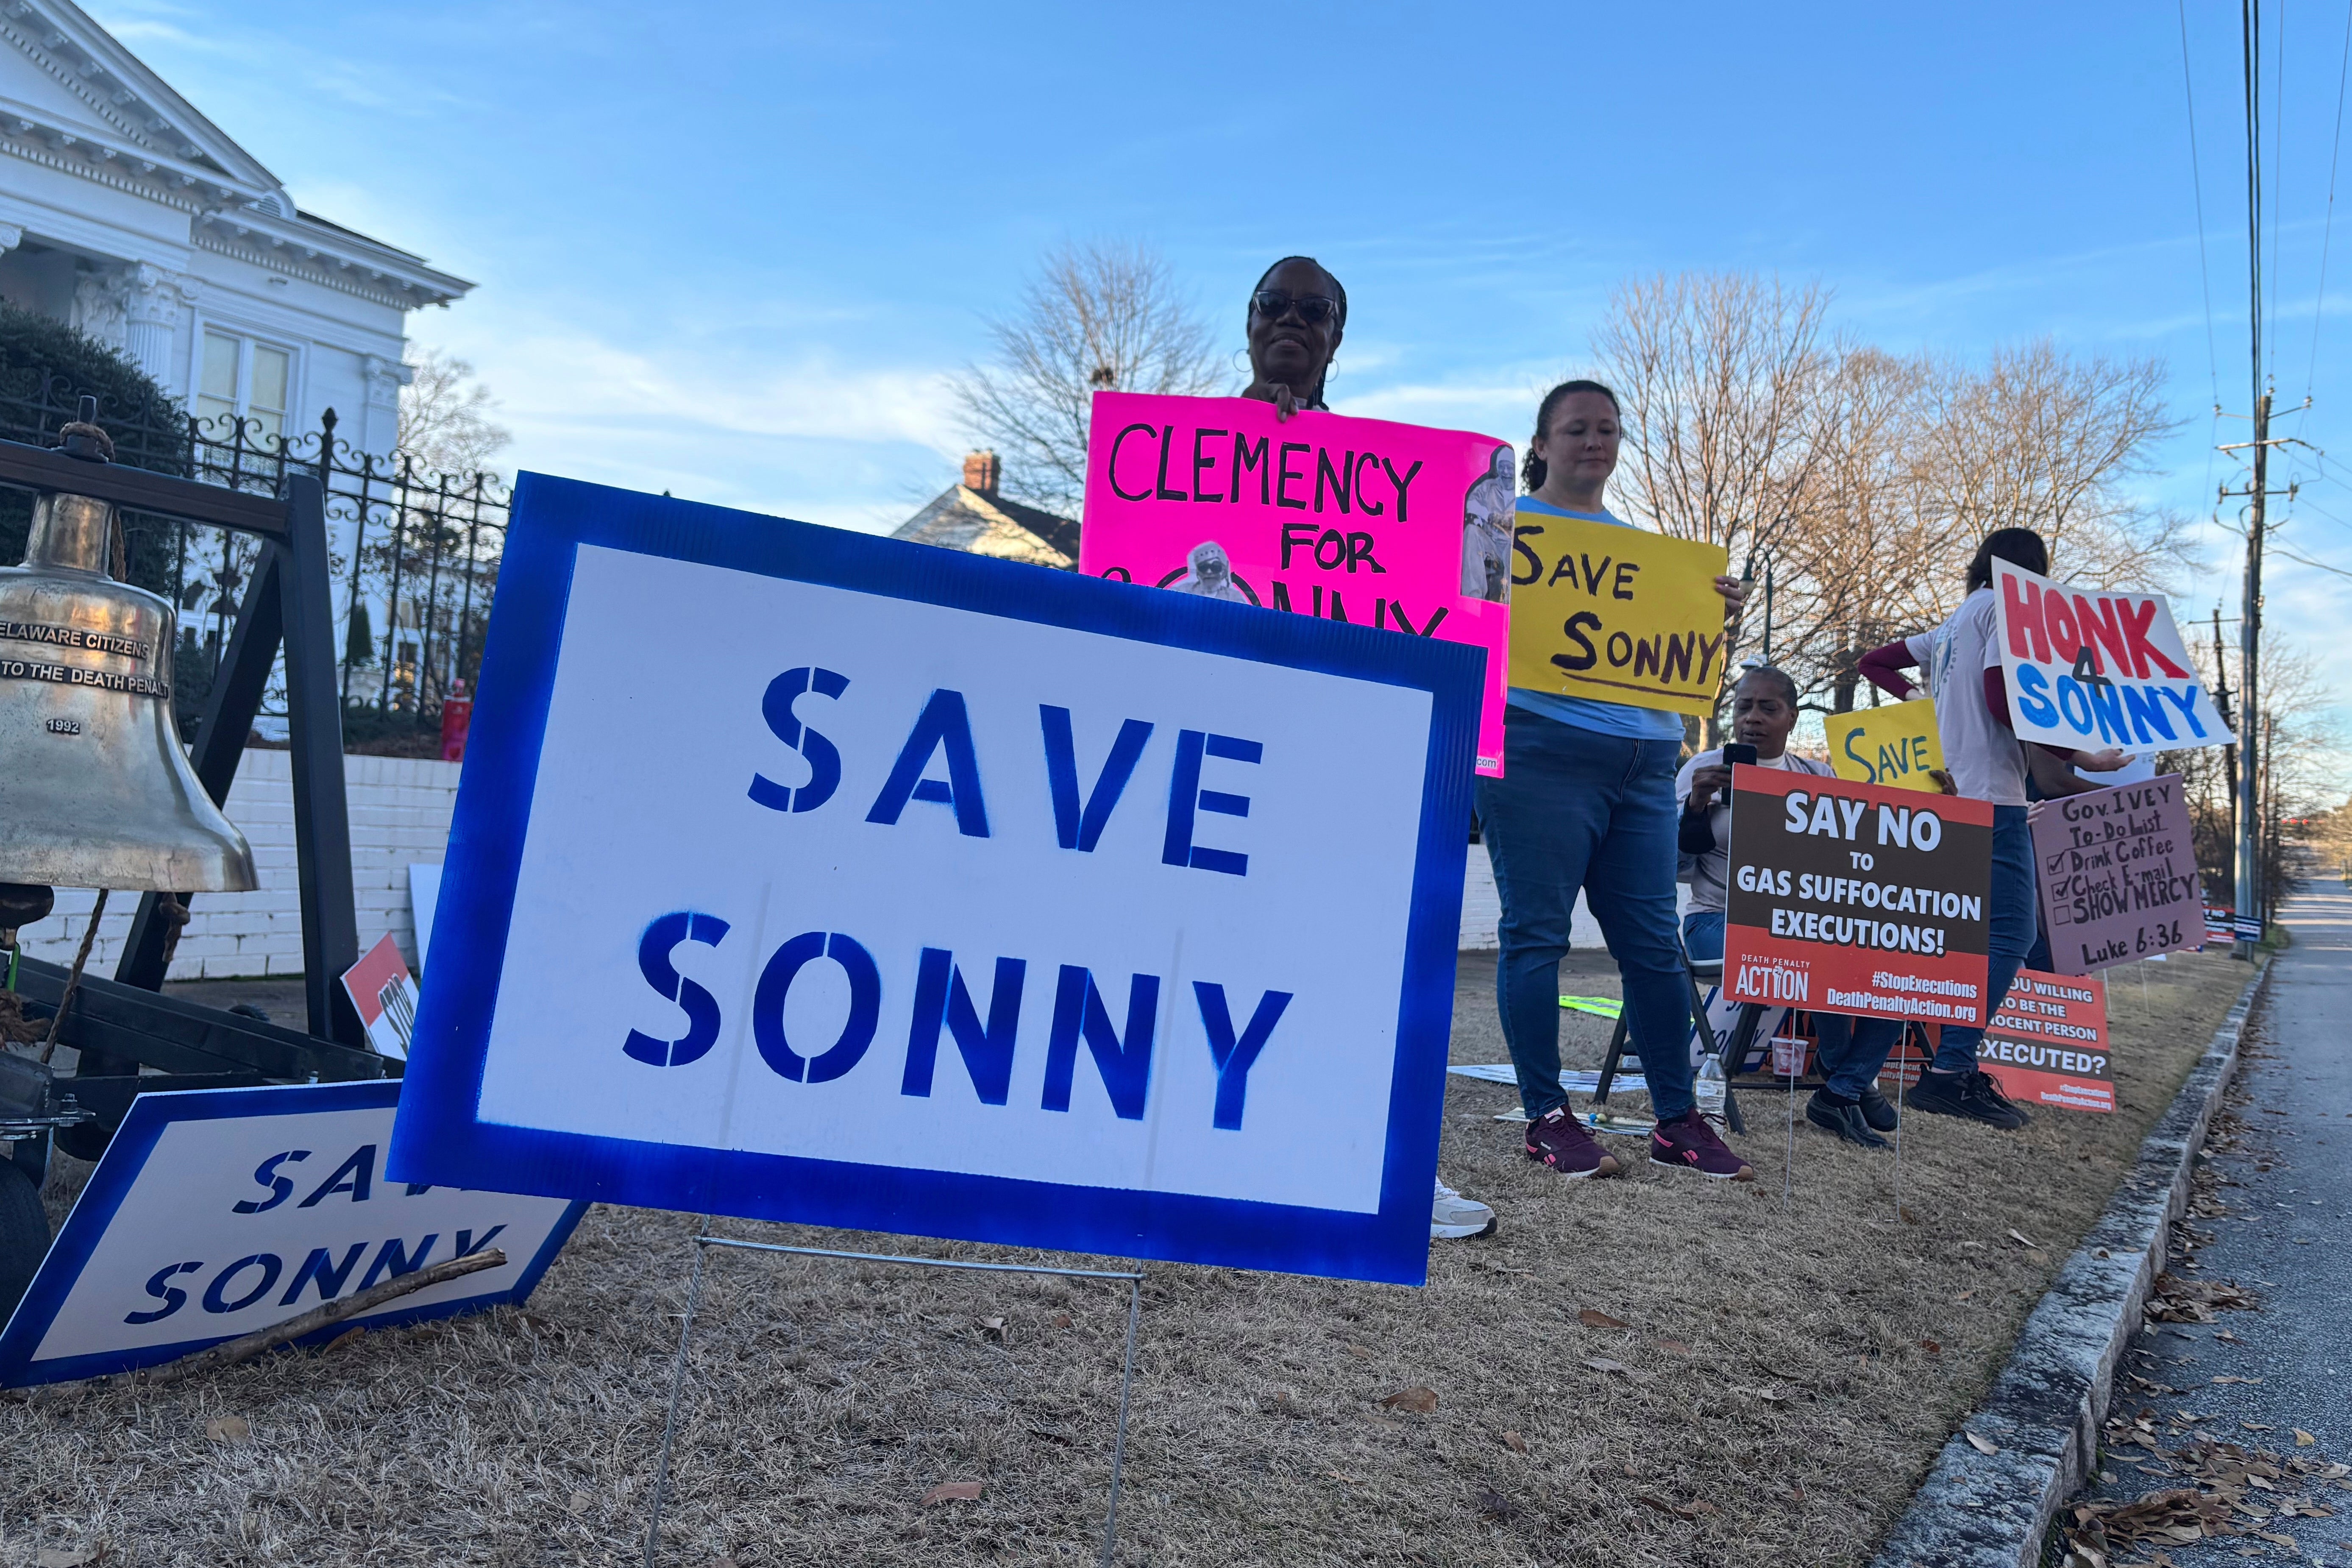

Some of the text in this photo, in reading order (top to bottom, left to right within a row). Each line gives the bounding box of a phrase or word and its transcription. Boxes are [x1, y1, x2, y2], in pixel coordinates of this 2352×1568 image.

[1109, 423, 1423, 523] CLEMENCY
[1281, 523, 1386, 573] FOR
[1511, 526, 1640, 600] SAVE
[86, 635, 150, 660] CITIZENS
[1550, 611, 1723, 685] SONNY
[2002, 573, 2191, 679] HONK
[2, 661, 25, 677] TO
[30, 664, 64, 682] THE
[71, 668, 124, 690] DEATH
[2072, 646, 2114, 699] 4
[47, 720, 80, 733] 1992
[2016, 663, 2207, 745] SONNY
[747, 666, 1264, 877] SAVE
[1845, 727, 1930, 783] SAVE
[1785, 792, 1941, 852] SAY NO
[2113, 785, 2170, 814] IVEY
[1850, 851, 1873, 871] TO
[2071, 836, 2174, 873] Drink Coffee
[1737, 865, 1981, 921] GAS SUFFOCATION
[2071, 869, 2118, 897] Check
[2074, 873, 2195, 924] SHOW MERCY
[1771, 908, 1944, 955] EXECUTIONS!
[2082, 919, 2183, 966] Luke 6:36
[1742, 954, 1810, 969] DEATH PENALTY
[1872, 971, 1977, 999] #StopExecutions
[1827, 988, 1977, 1022] DeathPenaltyAction.org
[2019, 999, 2037, 1013] BE
[2037, 1001, 2066, 1017] THE
[2034, 982, 2093, 1003] WILLING
[621, 912, 1294, 1131] SONNY
[2044, 1021, 2097, 1042] PERSON
